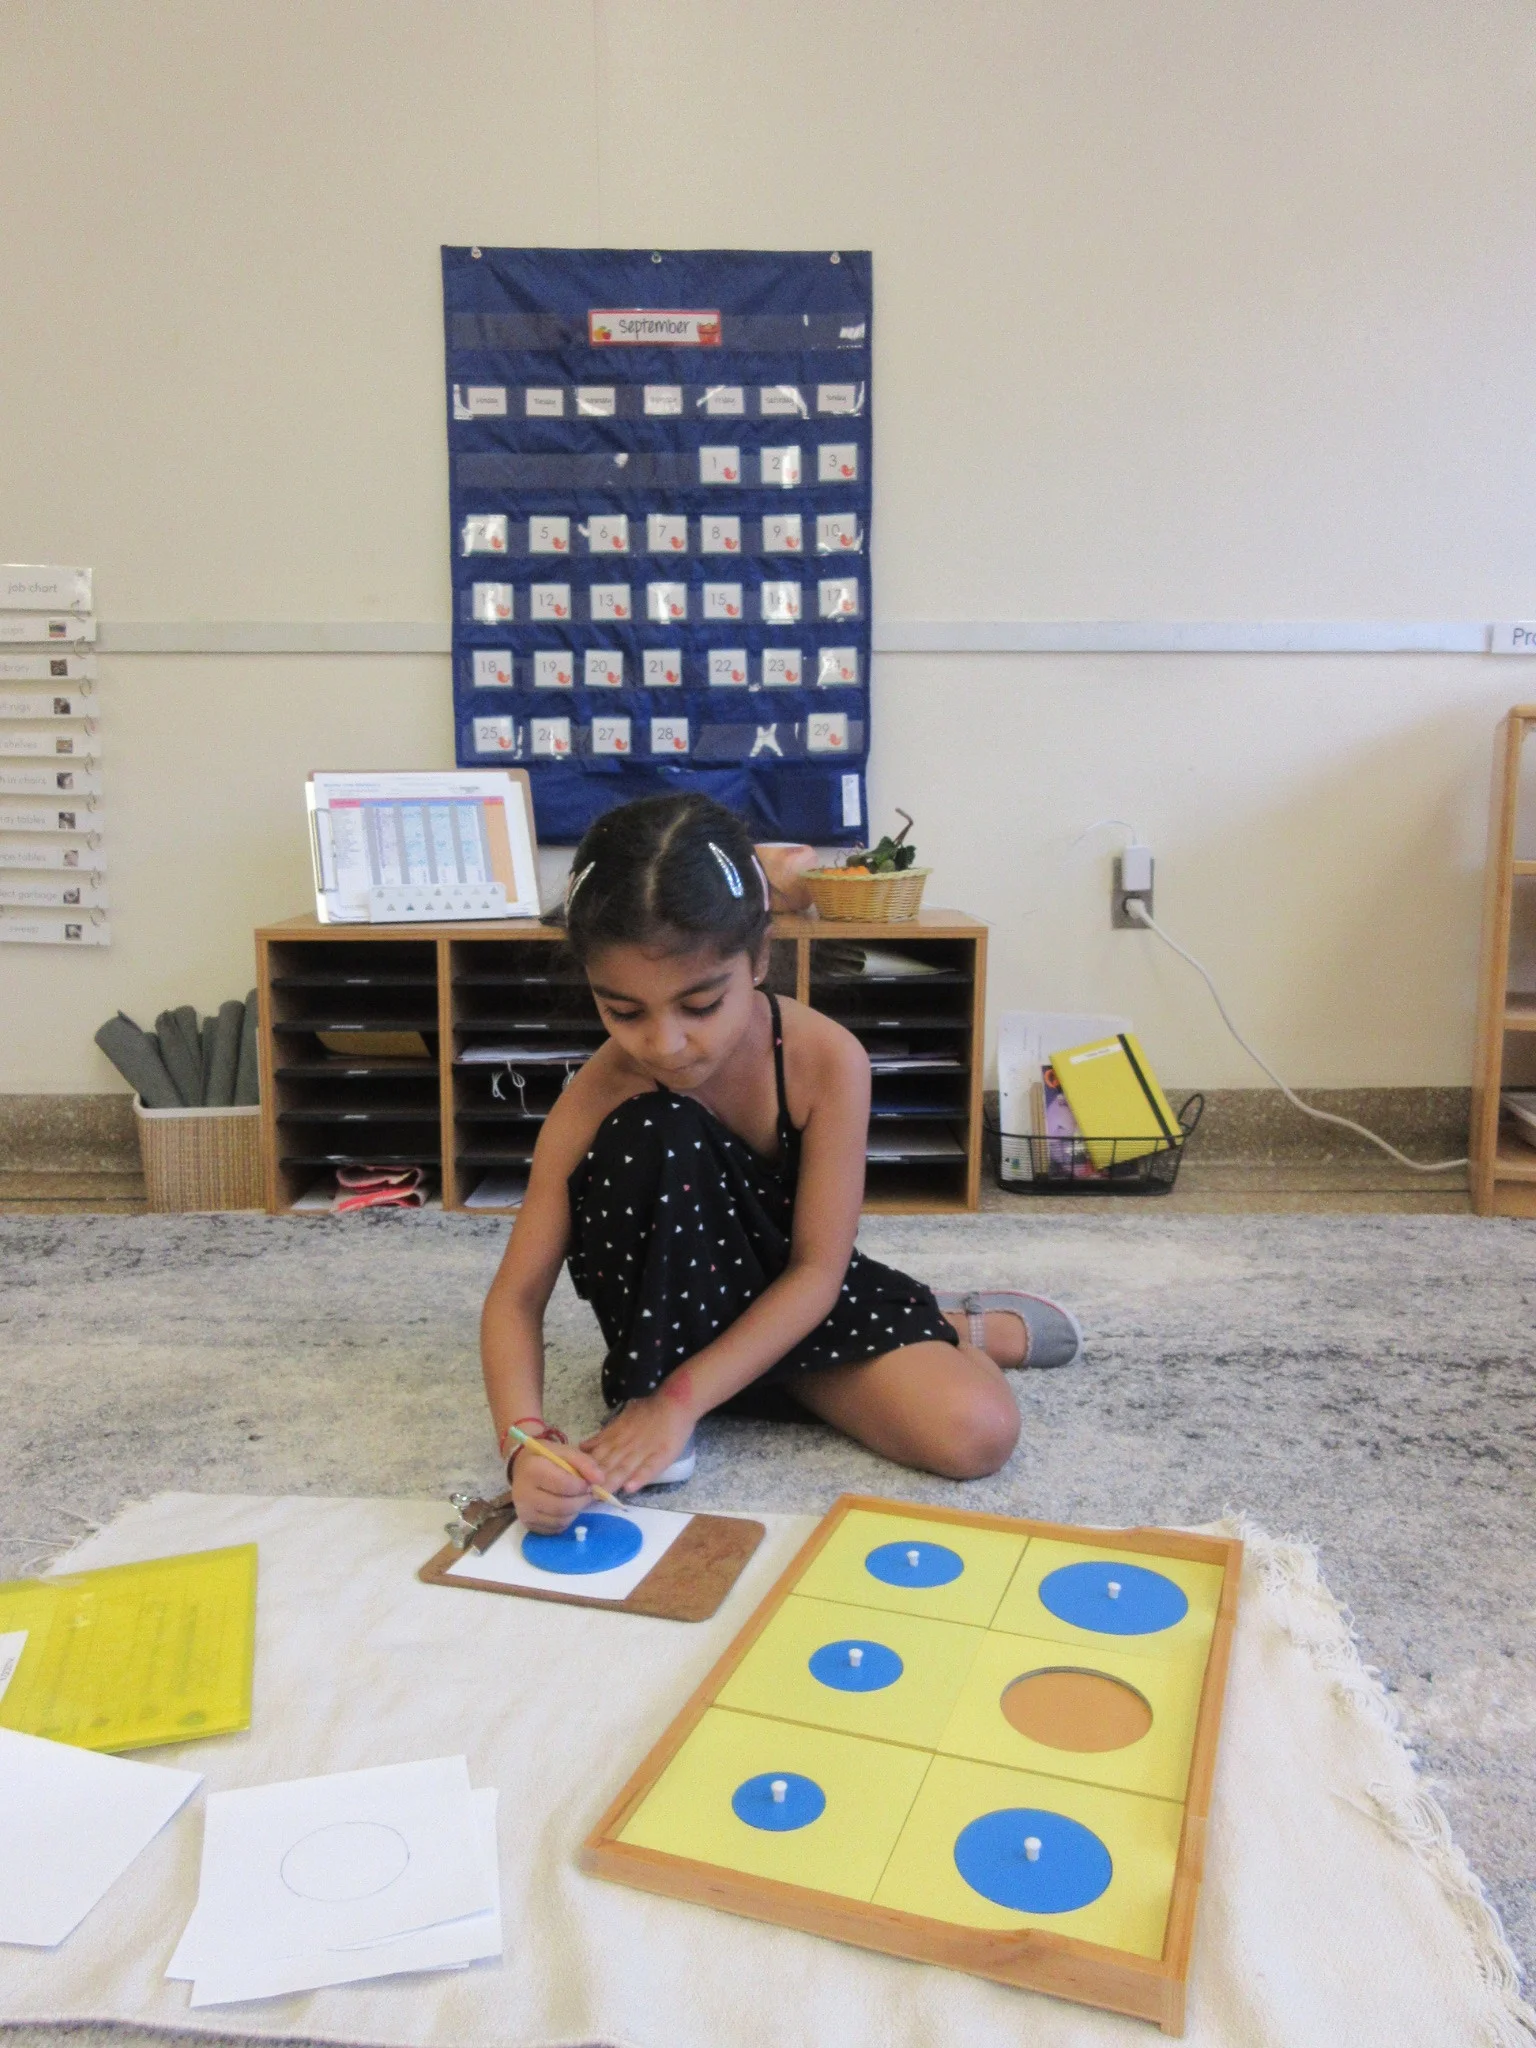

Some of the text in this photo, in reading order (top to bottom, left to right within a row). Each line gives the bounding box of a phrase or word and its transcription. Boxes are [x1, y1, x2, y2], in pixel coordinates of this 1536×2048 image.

[712, 454, 837, 470] 1 2 3
[540, 526, 549, 540] 5
[599, 525, 608, 539] 6
[658, 525, 667, 538] 7
[711, 525, 720, 540] 8
[773, 525, 781, 538] 9
[824, 524, 840, 537] 10
[8, 582, 57, 594] job chart
[539, 593, 554, 607] 12
[599, 593, 614, 607] 13
[711, 593, 727, 606] 15
[827, 588, 841, 602] 17
[480, 660, 497, 673] 18
[542, 660, 557, 673] 19
[591, 660, 607, 673] 20
[649, 660, 664, 673] 21
[715, 659, 731, 673] 22
[769, 659, 785, 672] 23
[480, 727, 498, 740] 25
[598, 727, 615, 741] 27
[657, 727, 674, 740] 28
[814, 723, 830, 736] 29
